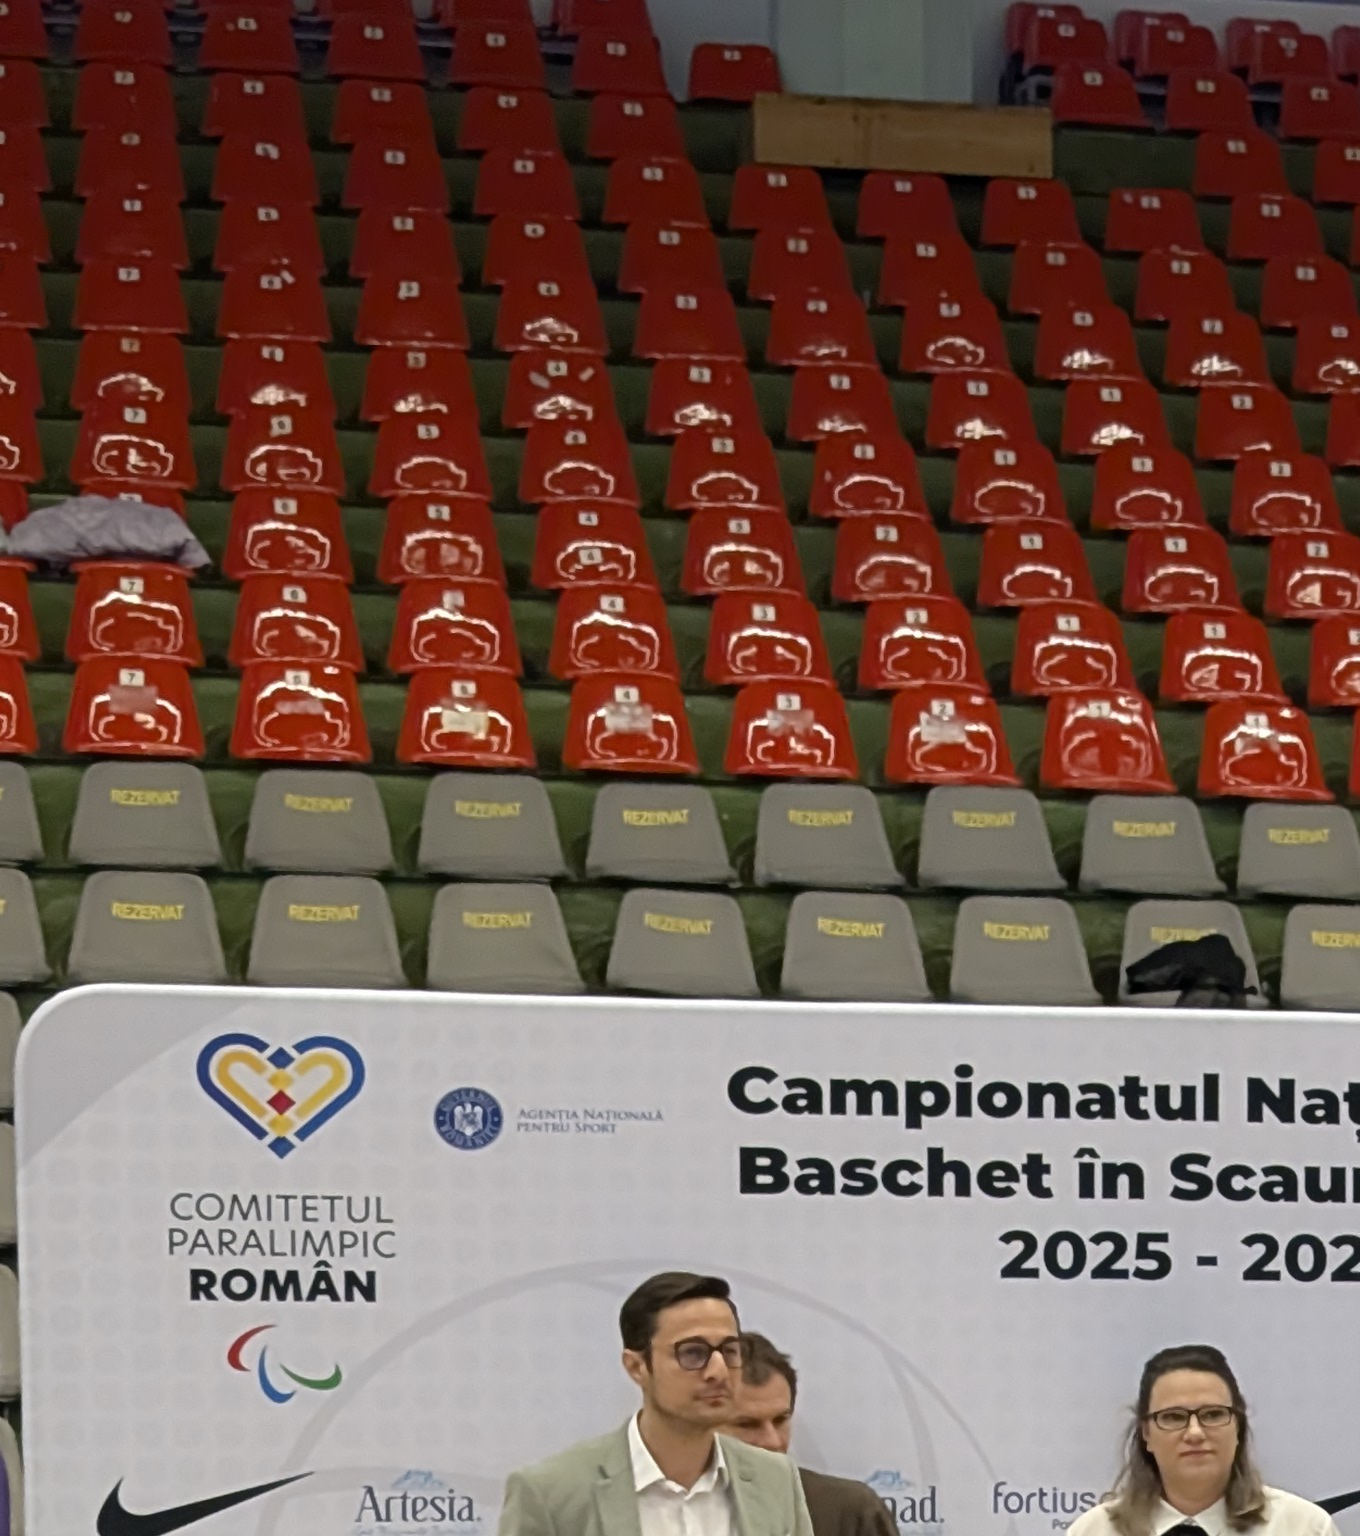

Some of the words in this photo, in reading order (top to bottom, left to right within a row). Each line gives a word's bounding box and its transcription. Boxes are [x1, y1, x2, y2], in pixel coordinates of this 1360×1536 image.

[728, 1064, 1219, 1129] Campionatul
[740, 1147, 1053, 1198] Baschet
[1074, 1148, 1144, 1199] în
[170, 1193, 393, 1223] COMITETUL
[169, 1228, 395, 1258] PARALIMPIC
[999, 1230, 1171, 1280] 2025
[190, 1260, 376, 1302] ROMÂN
